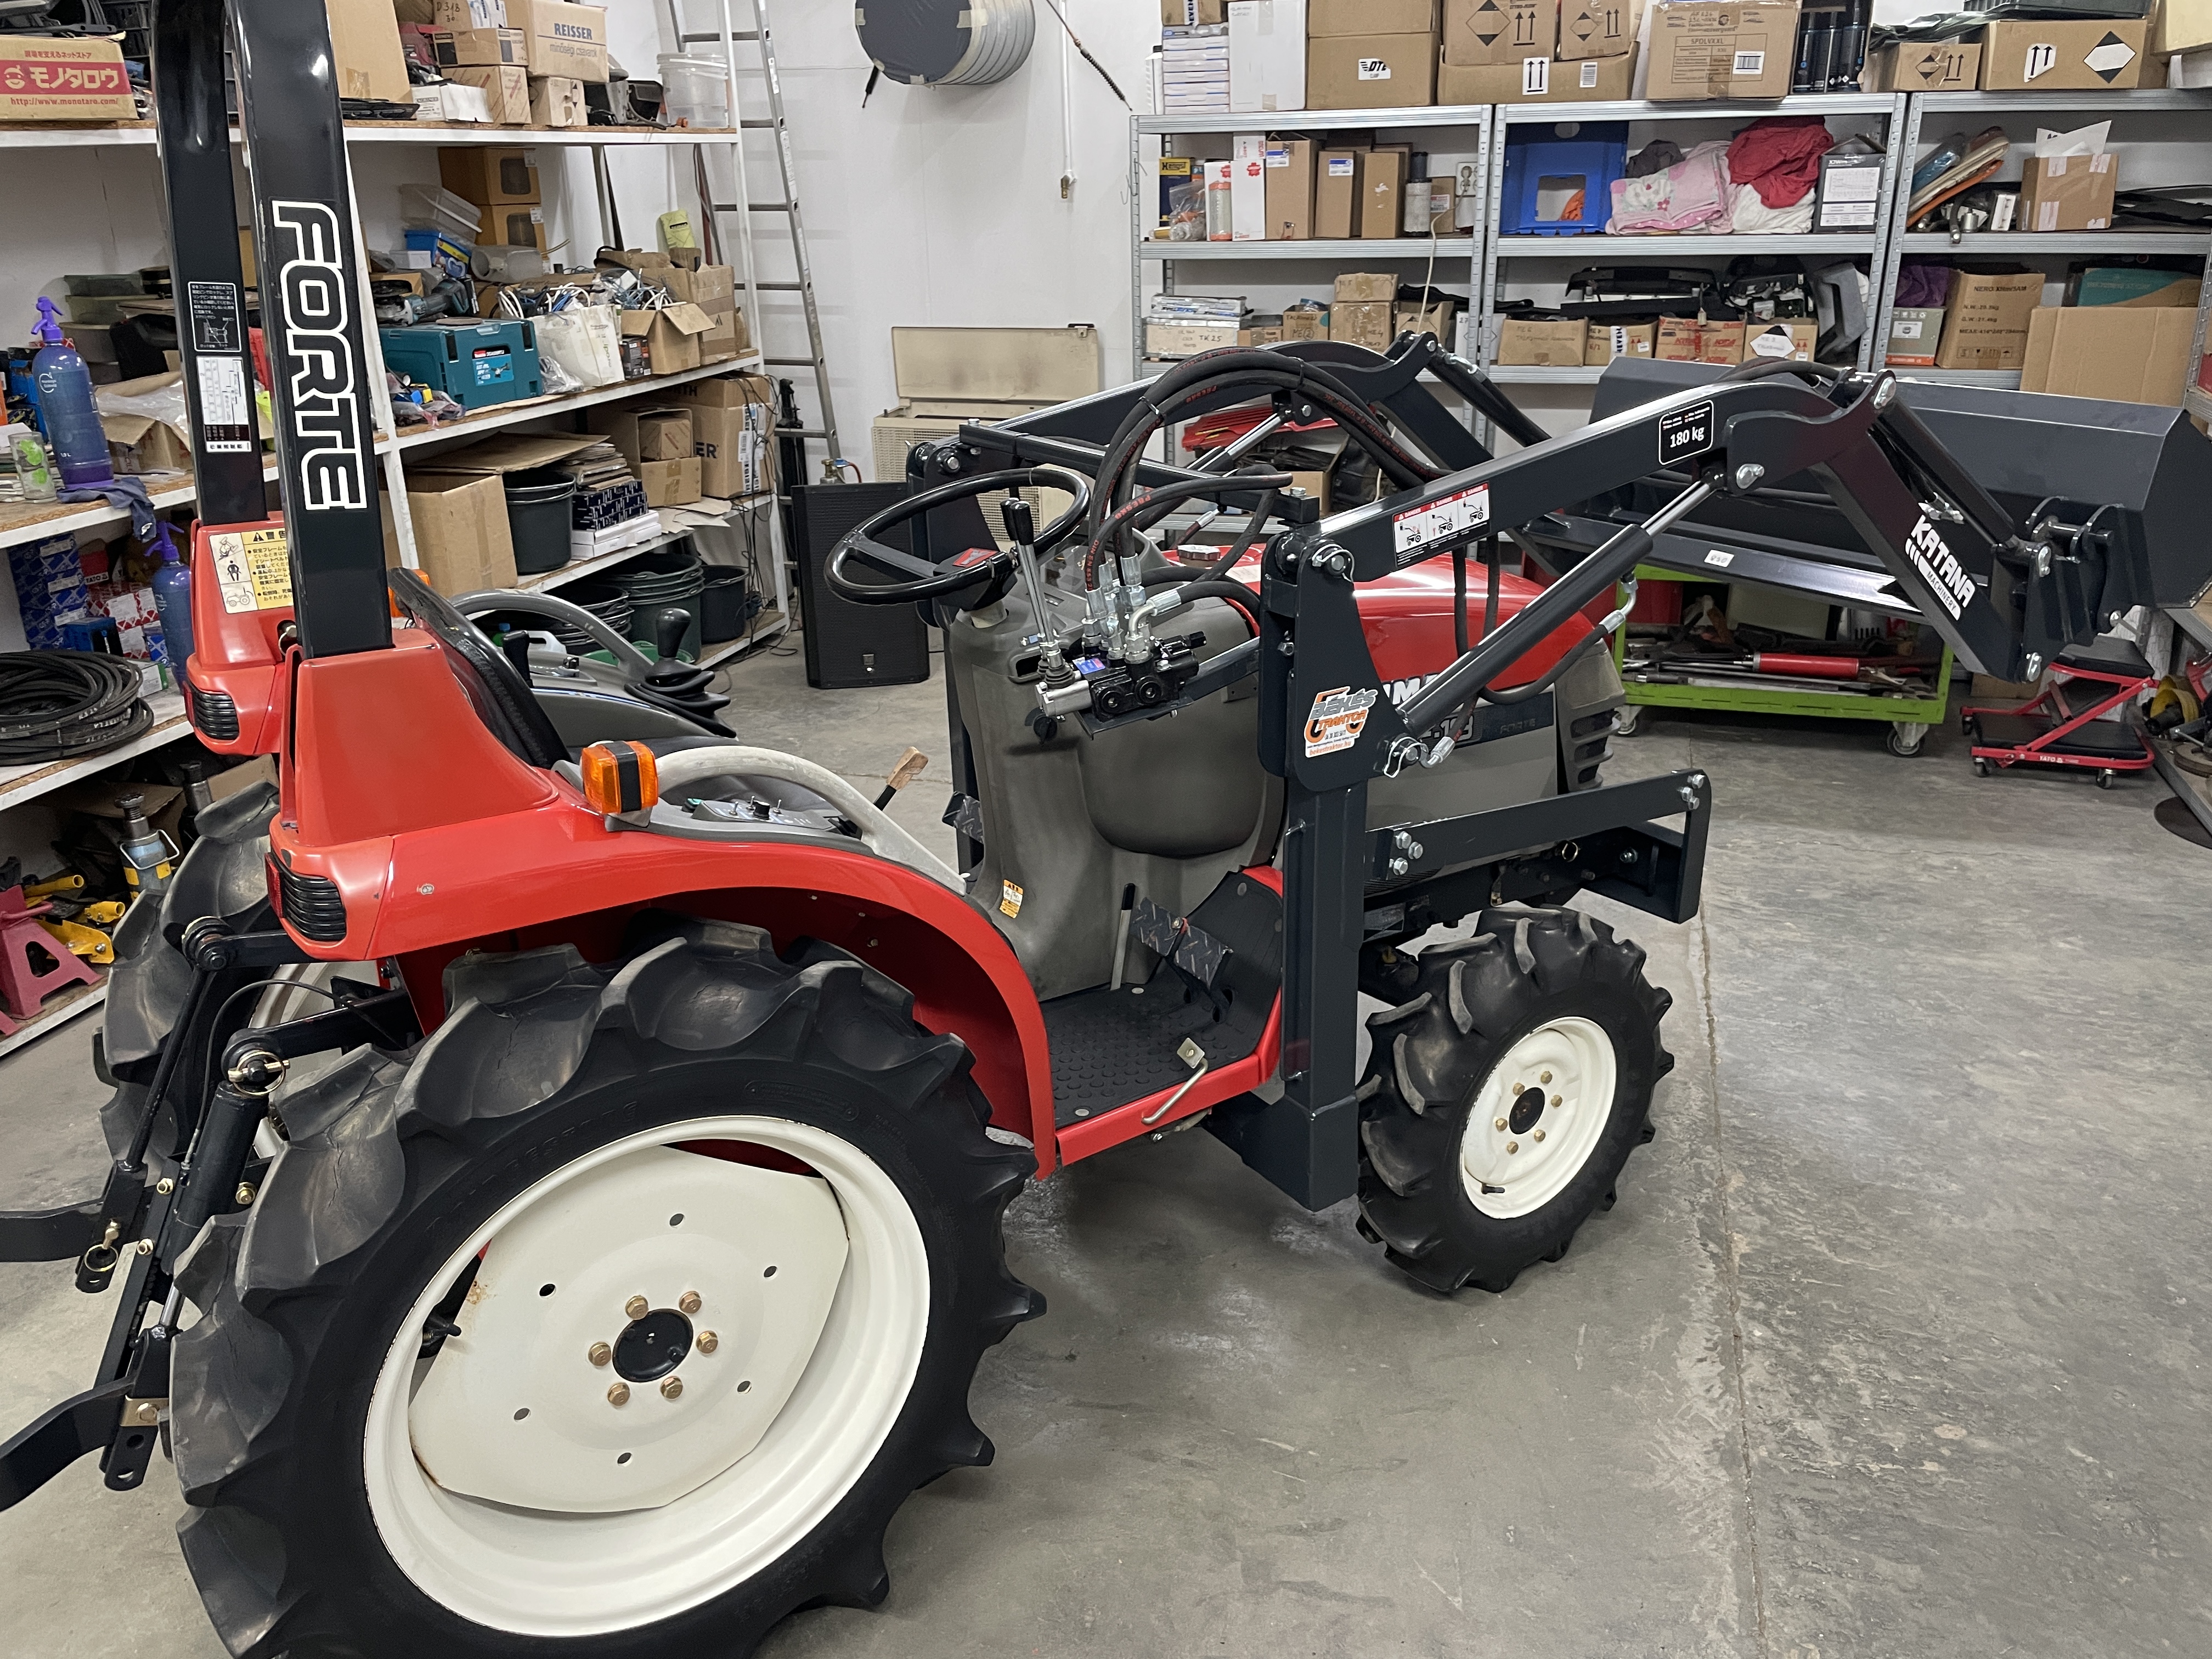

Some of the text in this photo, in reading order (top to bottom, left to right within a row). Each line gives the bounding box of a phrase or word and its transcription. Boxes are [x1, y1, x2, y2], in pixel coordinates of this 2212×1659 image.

[554, 22, 593, 41] REISSER
[29, 66, 119, 89] モノタロウ
[10, 97, 119, 106] http://www.monotaro.com/
[272, 200, 367, 511] FORTE
[1670, 427, 1705, 448] 180 kg
[1911, 515, 1976, 608] KATANA
[1926, 571, 1957, 612] MACHINERY
[1310, 689, 1377, 720] BÉKÉS
[1318, 709, 1368, 730] TRAKTOR
[1500, 718, 1536, 734] FORTE
[1309, 741, 1352, 756] bekestraktor.hu
